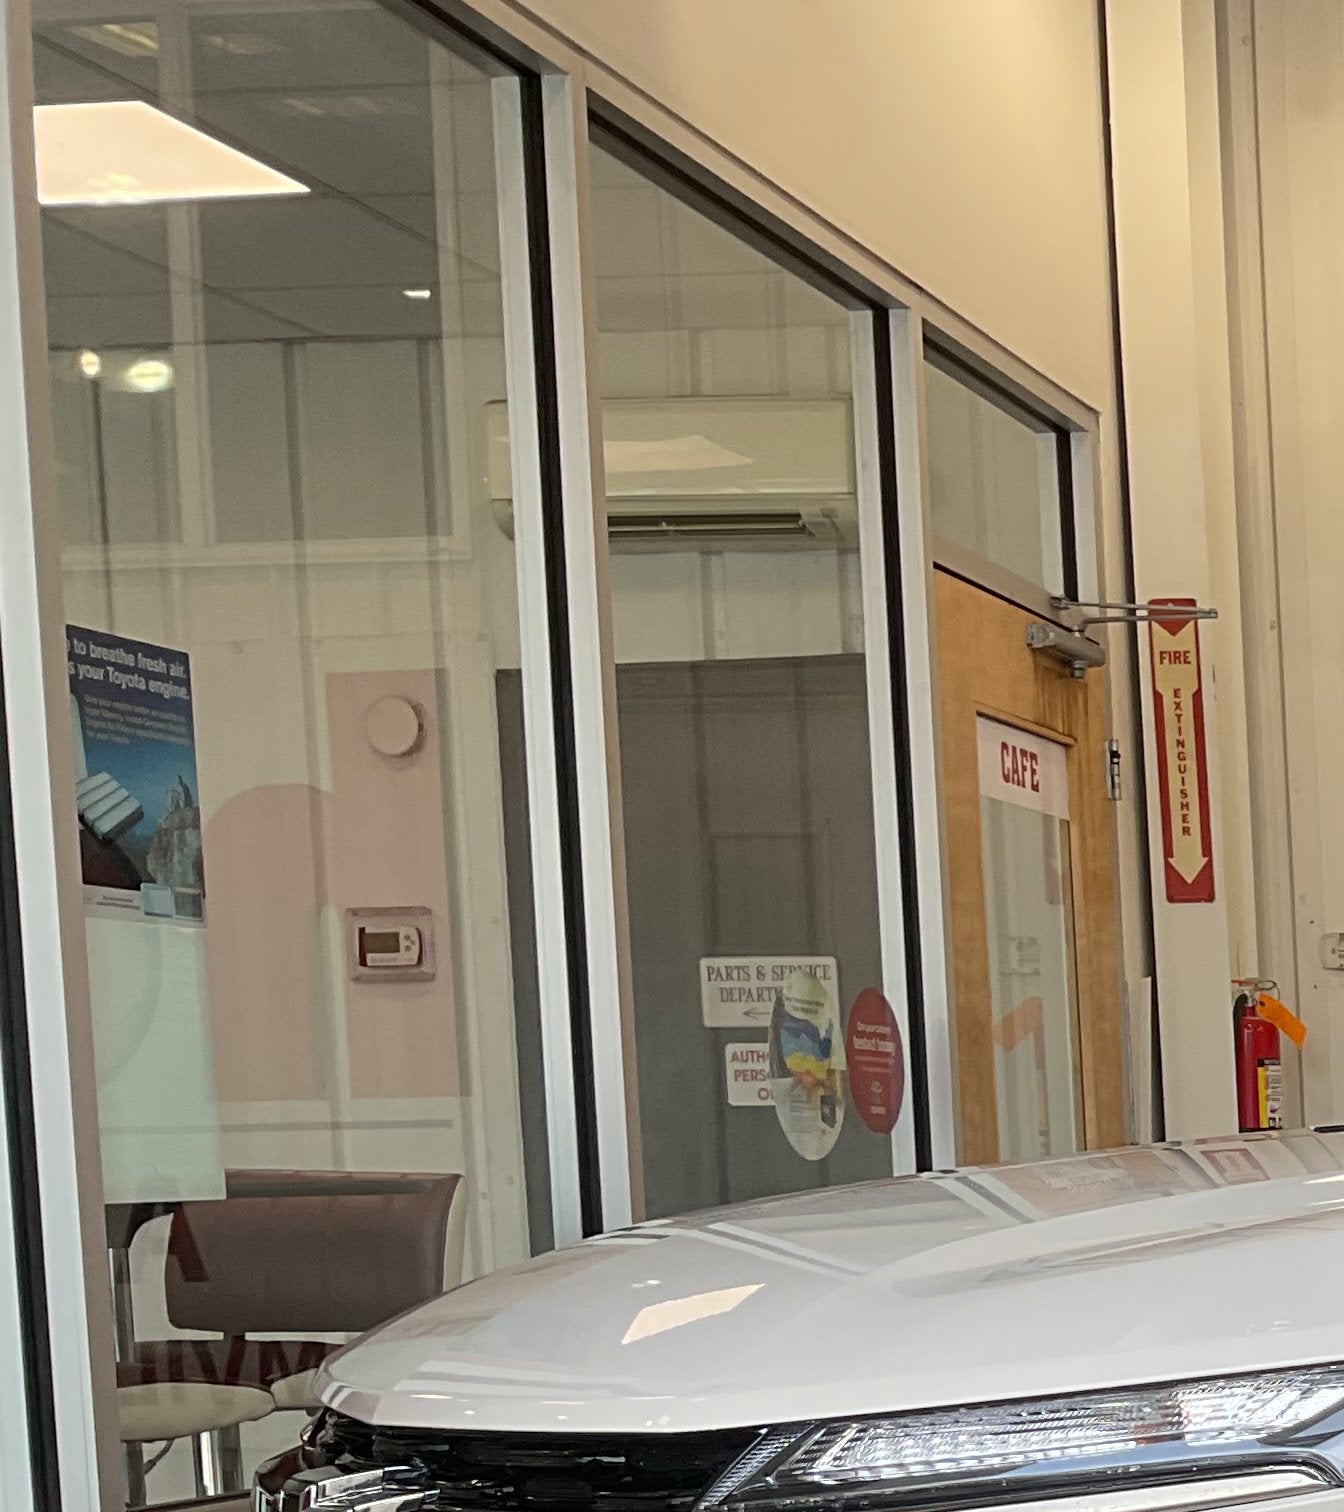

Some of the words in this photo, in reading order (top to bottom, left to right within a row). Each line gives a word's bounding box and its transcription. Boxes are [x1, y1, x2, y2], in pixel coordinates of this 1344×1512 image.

[74, 638, 87, 655] to
[89, 641, 135, 667] breathe
[1159, 650, 1192, 665] FIRE
[77, 663, 105, 680] your
[106, 665, 147, 690] Toyota
[1001, 741, 1040, 793] CAFE
[1173, 688, 1192, 836] EXTINGUISHER
[706, 965, 751, 982] PARTS
[756, 964, 767, 981] &
